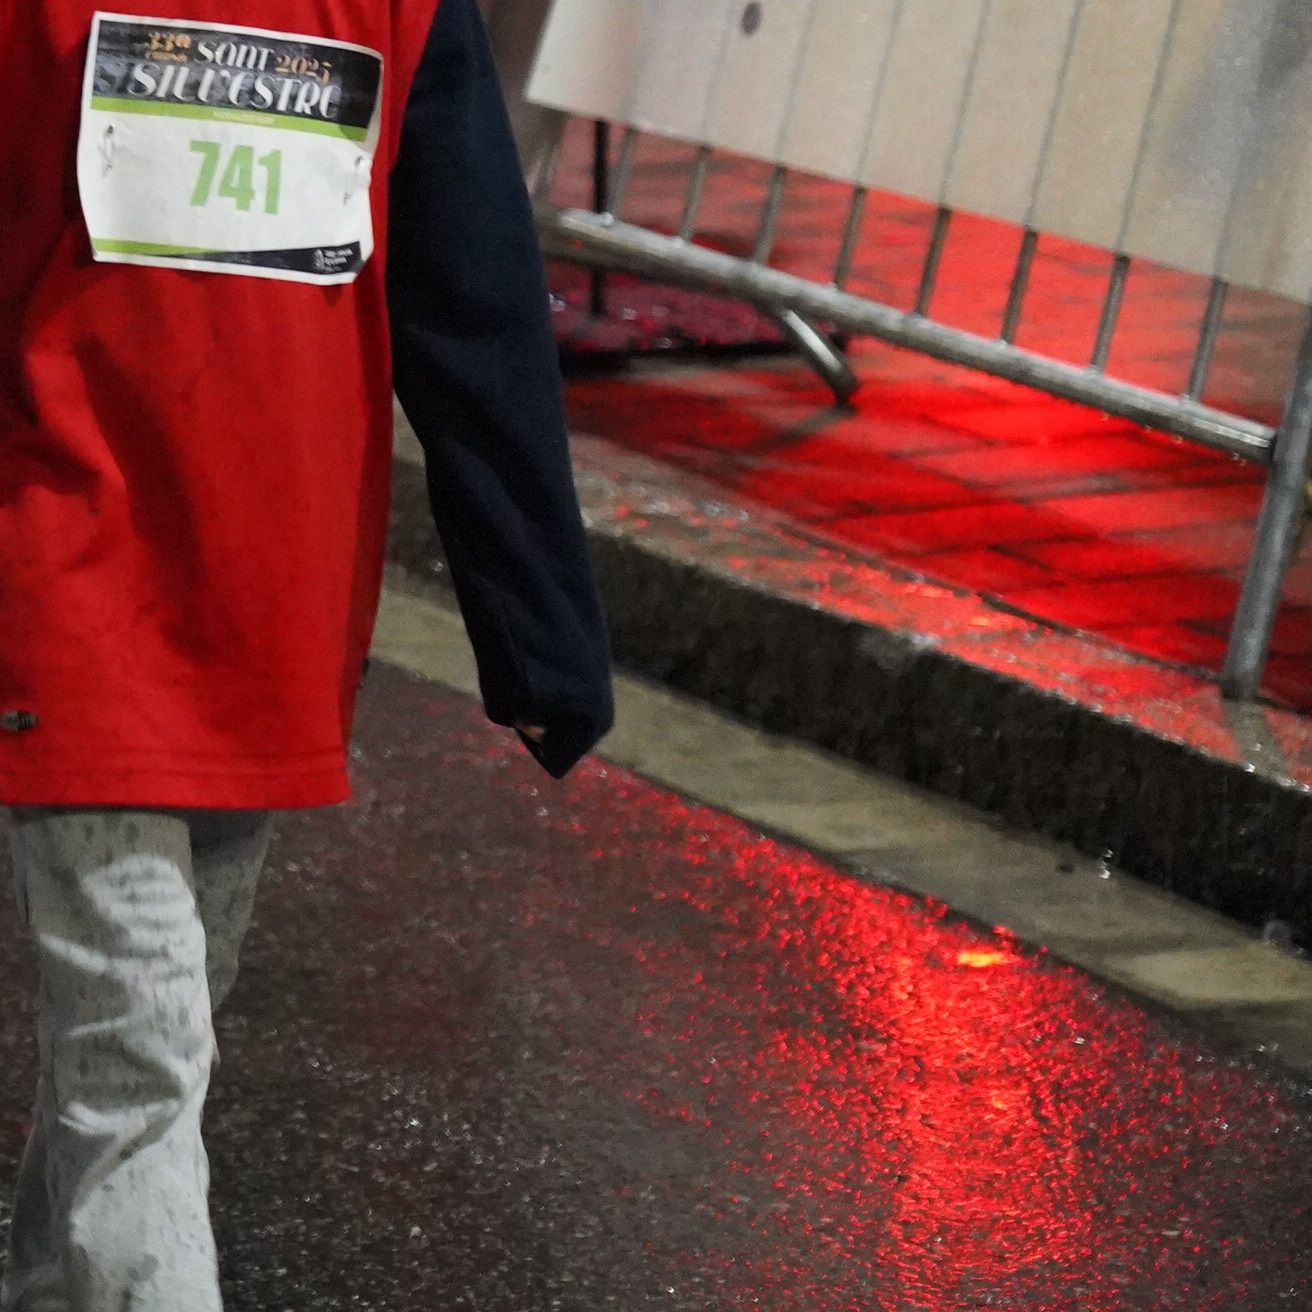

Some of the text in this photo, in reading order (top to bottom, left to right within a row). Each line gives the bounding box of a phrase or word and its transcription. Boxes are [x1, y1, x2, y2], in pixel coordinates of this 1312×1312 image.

[194, 41, 275, 71] SANT
[128, 61, 342, 119] SILVESTRE
[189, 139, 283, 216] 741
